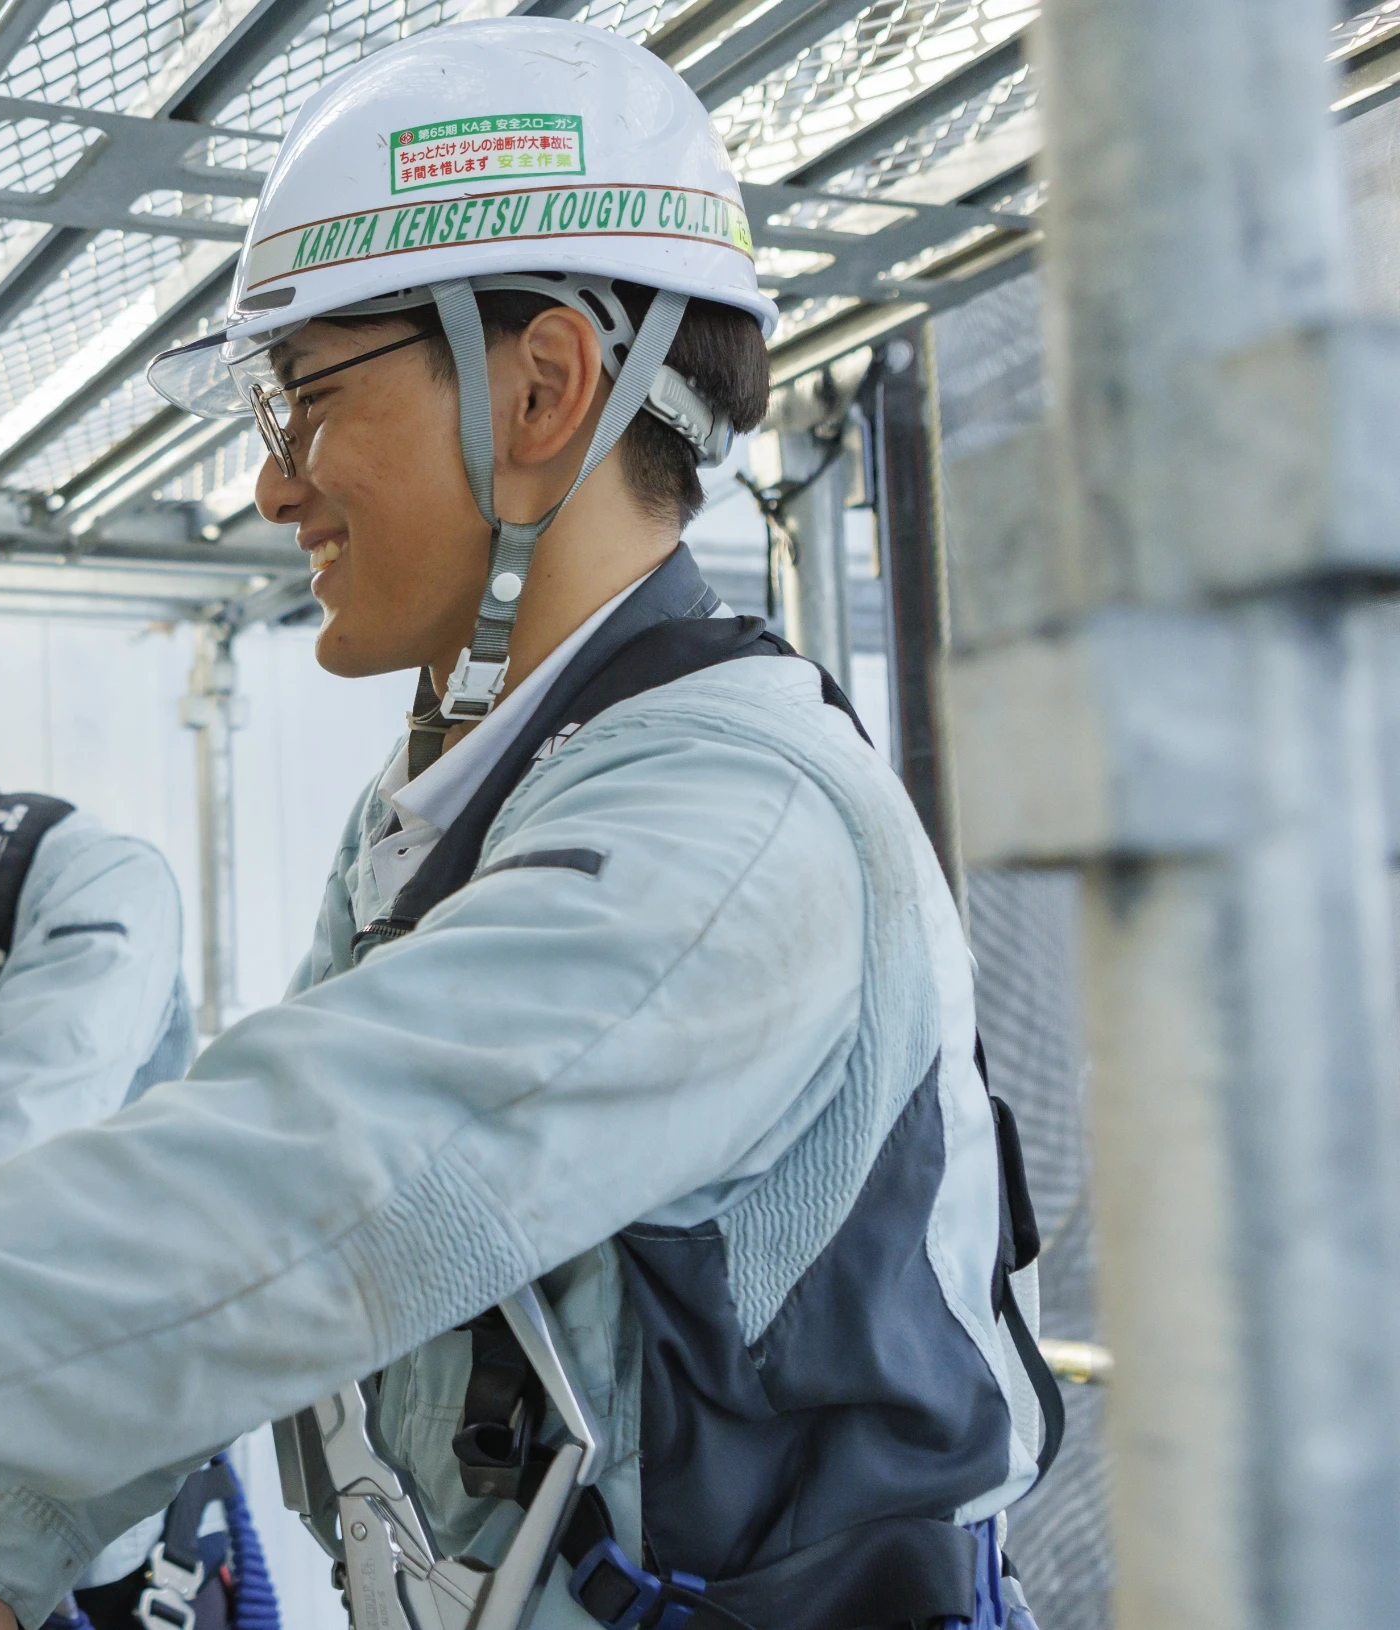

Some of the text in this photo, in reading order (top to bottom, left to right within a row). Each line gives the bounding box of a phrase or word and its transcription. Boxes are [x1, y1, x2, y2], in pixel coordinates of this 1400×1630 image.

[418, 118, 578, 141] 第65期 KA会 安全スローガン
[400, 135, 573, 165] ちょっとだけ 少しの油断が大事故に
[401, 153, 573, 183] 手間を惜しまず 安全作業
[292, 213, 380, 270] KARITA
[385, 195, 531, 251] KENSETSU
[538, 190, 646, 233] KOUGYO
